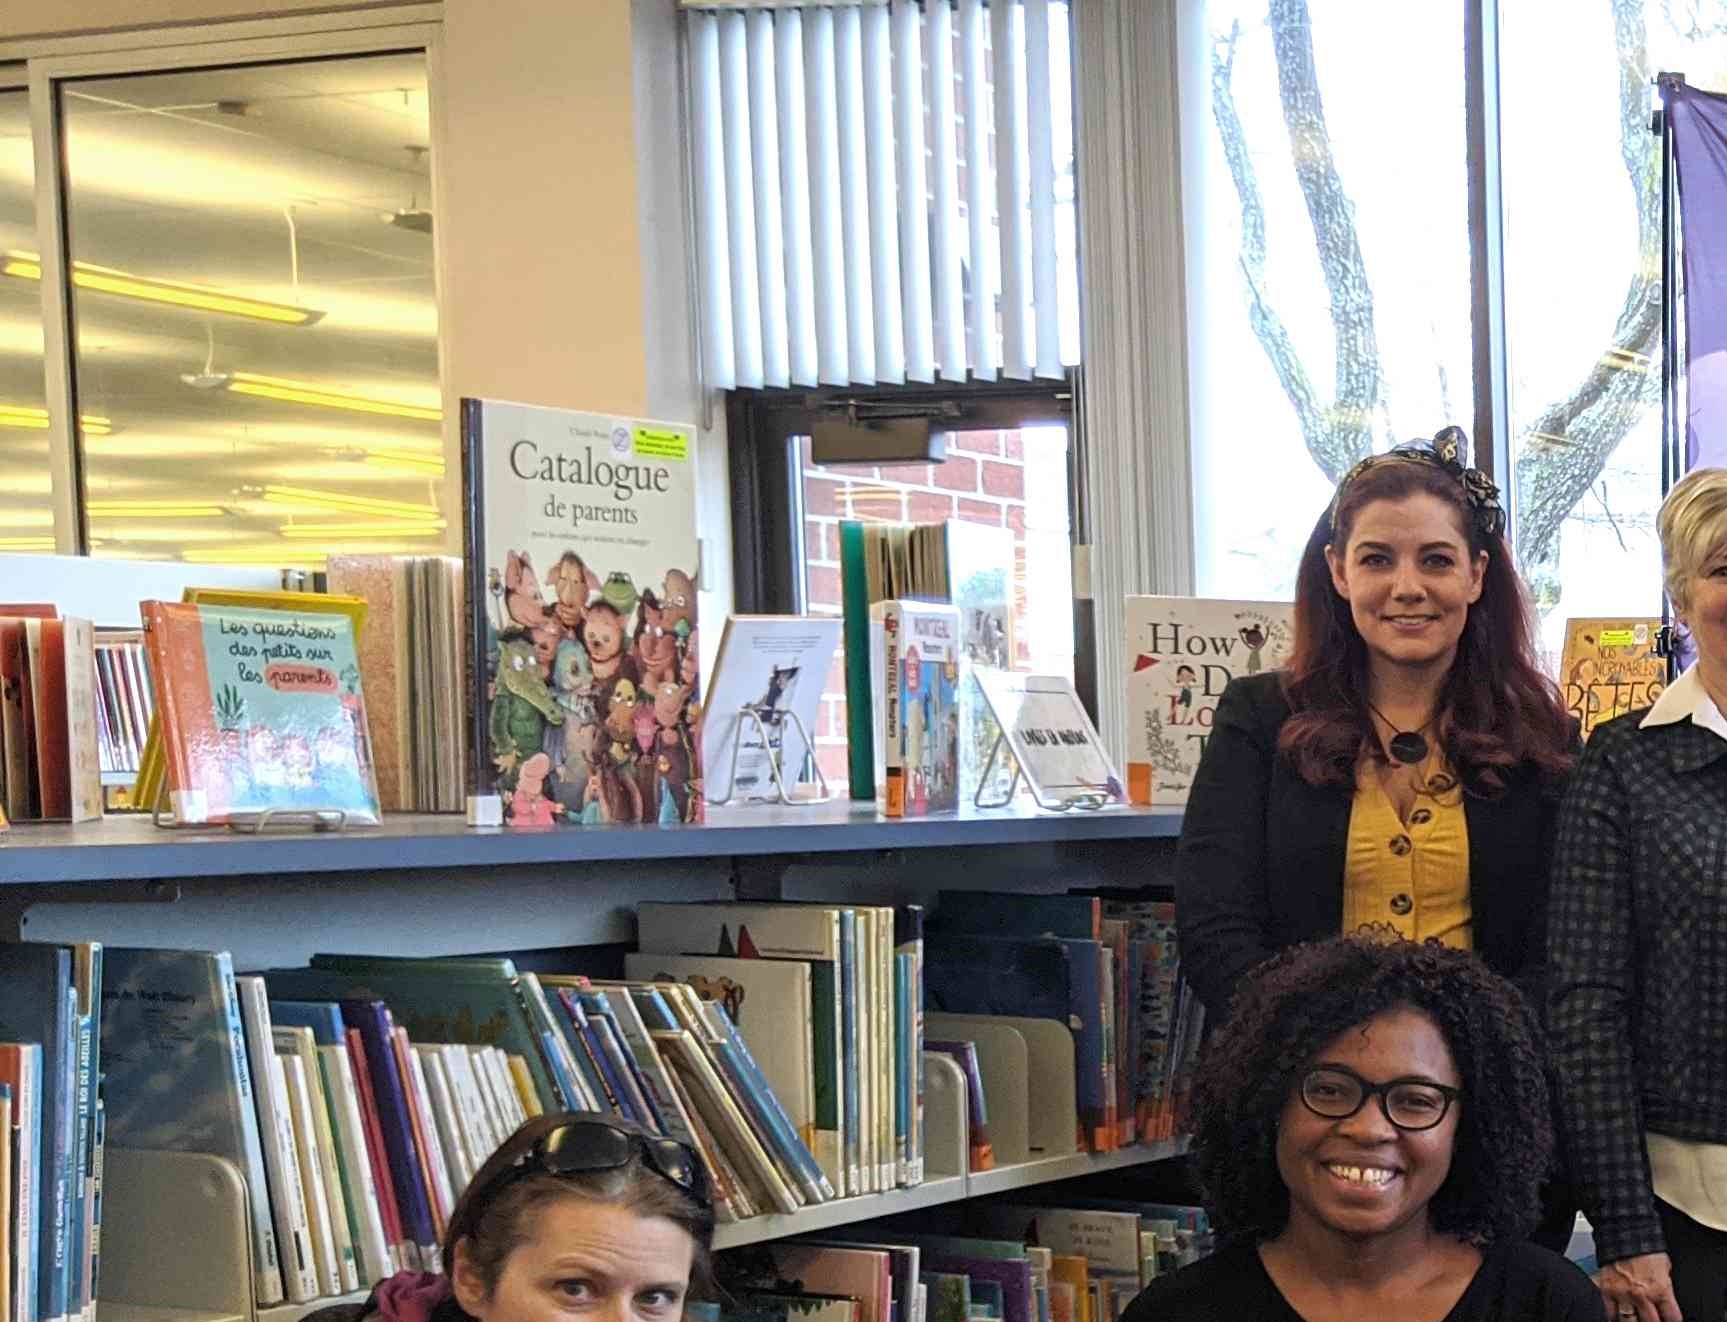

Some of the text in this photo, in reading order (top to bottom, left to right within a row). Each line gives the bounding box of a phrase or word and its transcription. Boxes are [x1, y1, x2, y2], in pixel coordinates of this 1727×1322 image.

[509, 439, 670, 501] Catalogue
[543, 494, 639, 527] de parents
[220, 617, 337, 645] Les questions
[1147, 622, 1239, 657] How
[228, 641, 335, 664] des petits sur
[237, 661, 333, 691] les parents
[1200, 664, 1233, 697] D
[1166, 694, 1216, 728] Lo
